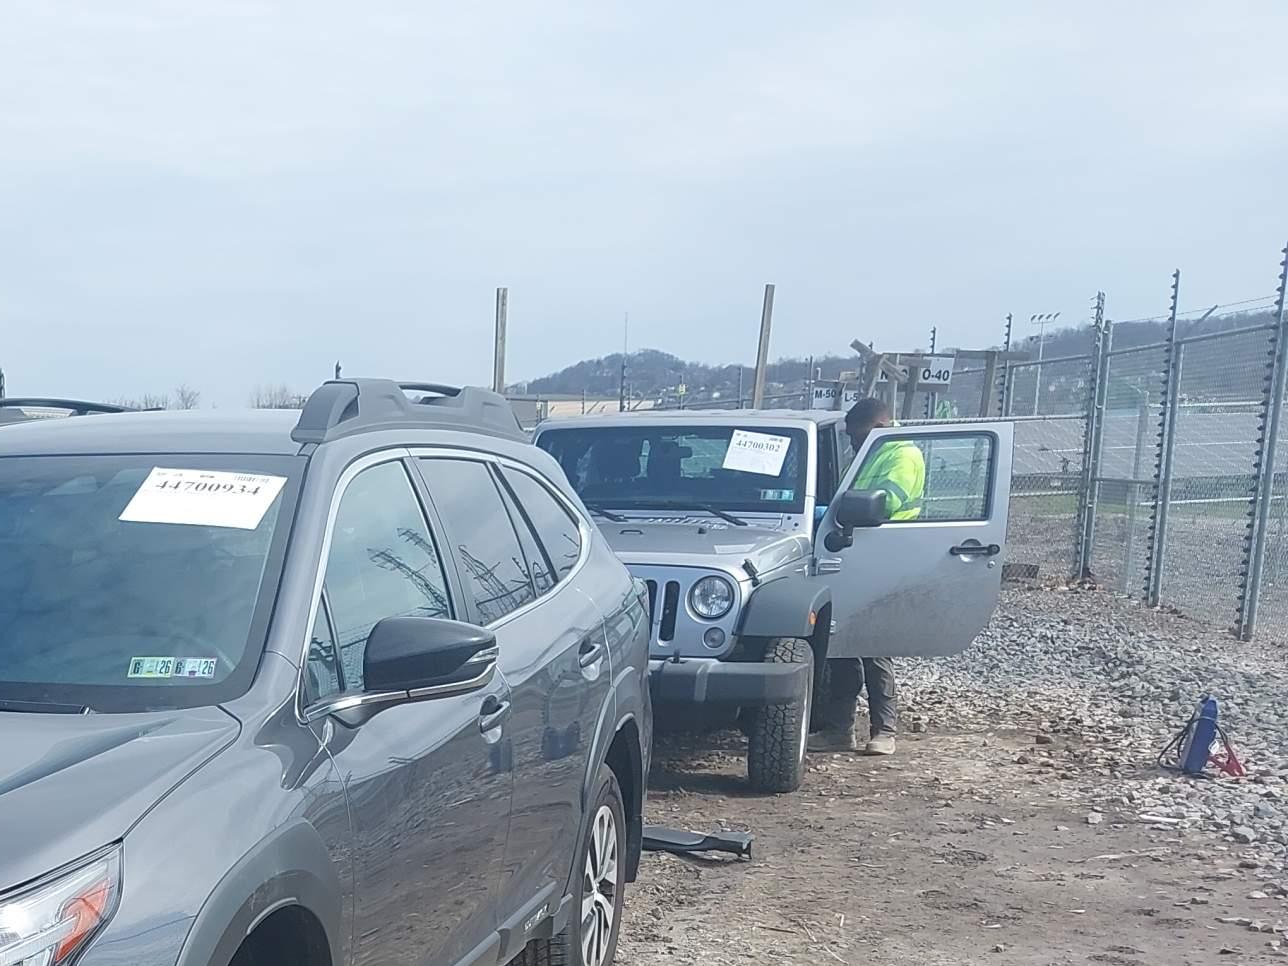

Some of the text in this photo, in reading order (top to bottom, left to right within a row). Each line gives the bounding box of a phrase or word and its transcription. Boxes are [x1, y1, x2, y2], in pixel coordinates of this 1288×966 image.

[922, 368, 950, 382] O-40
[844, 392, 858, 403] L-5
[156, 480, 260, 495] 44700934
